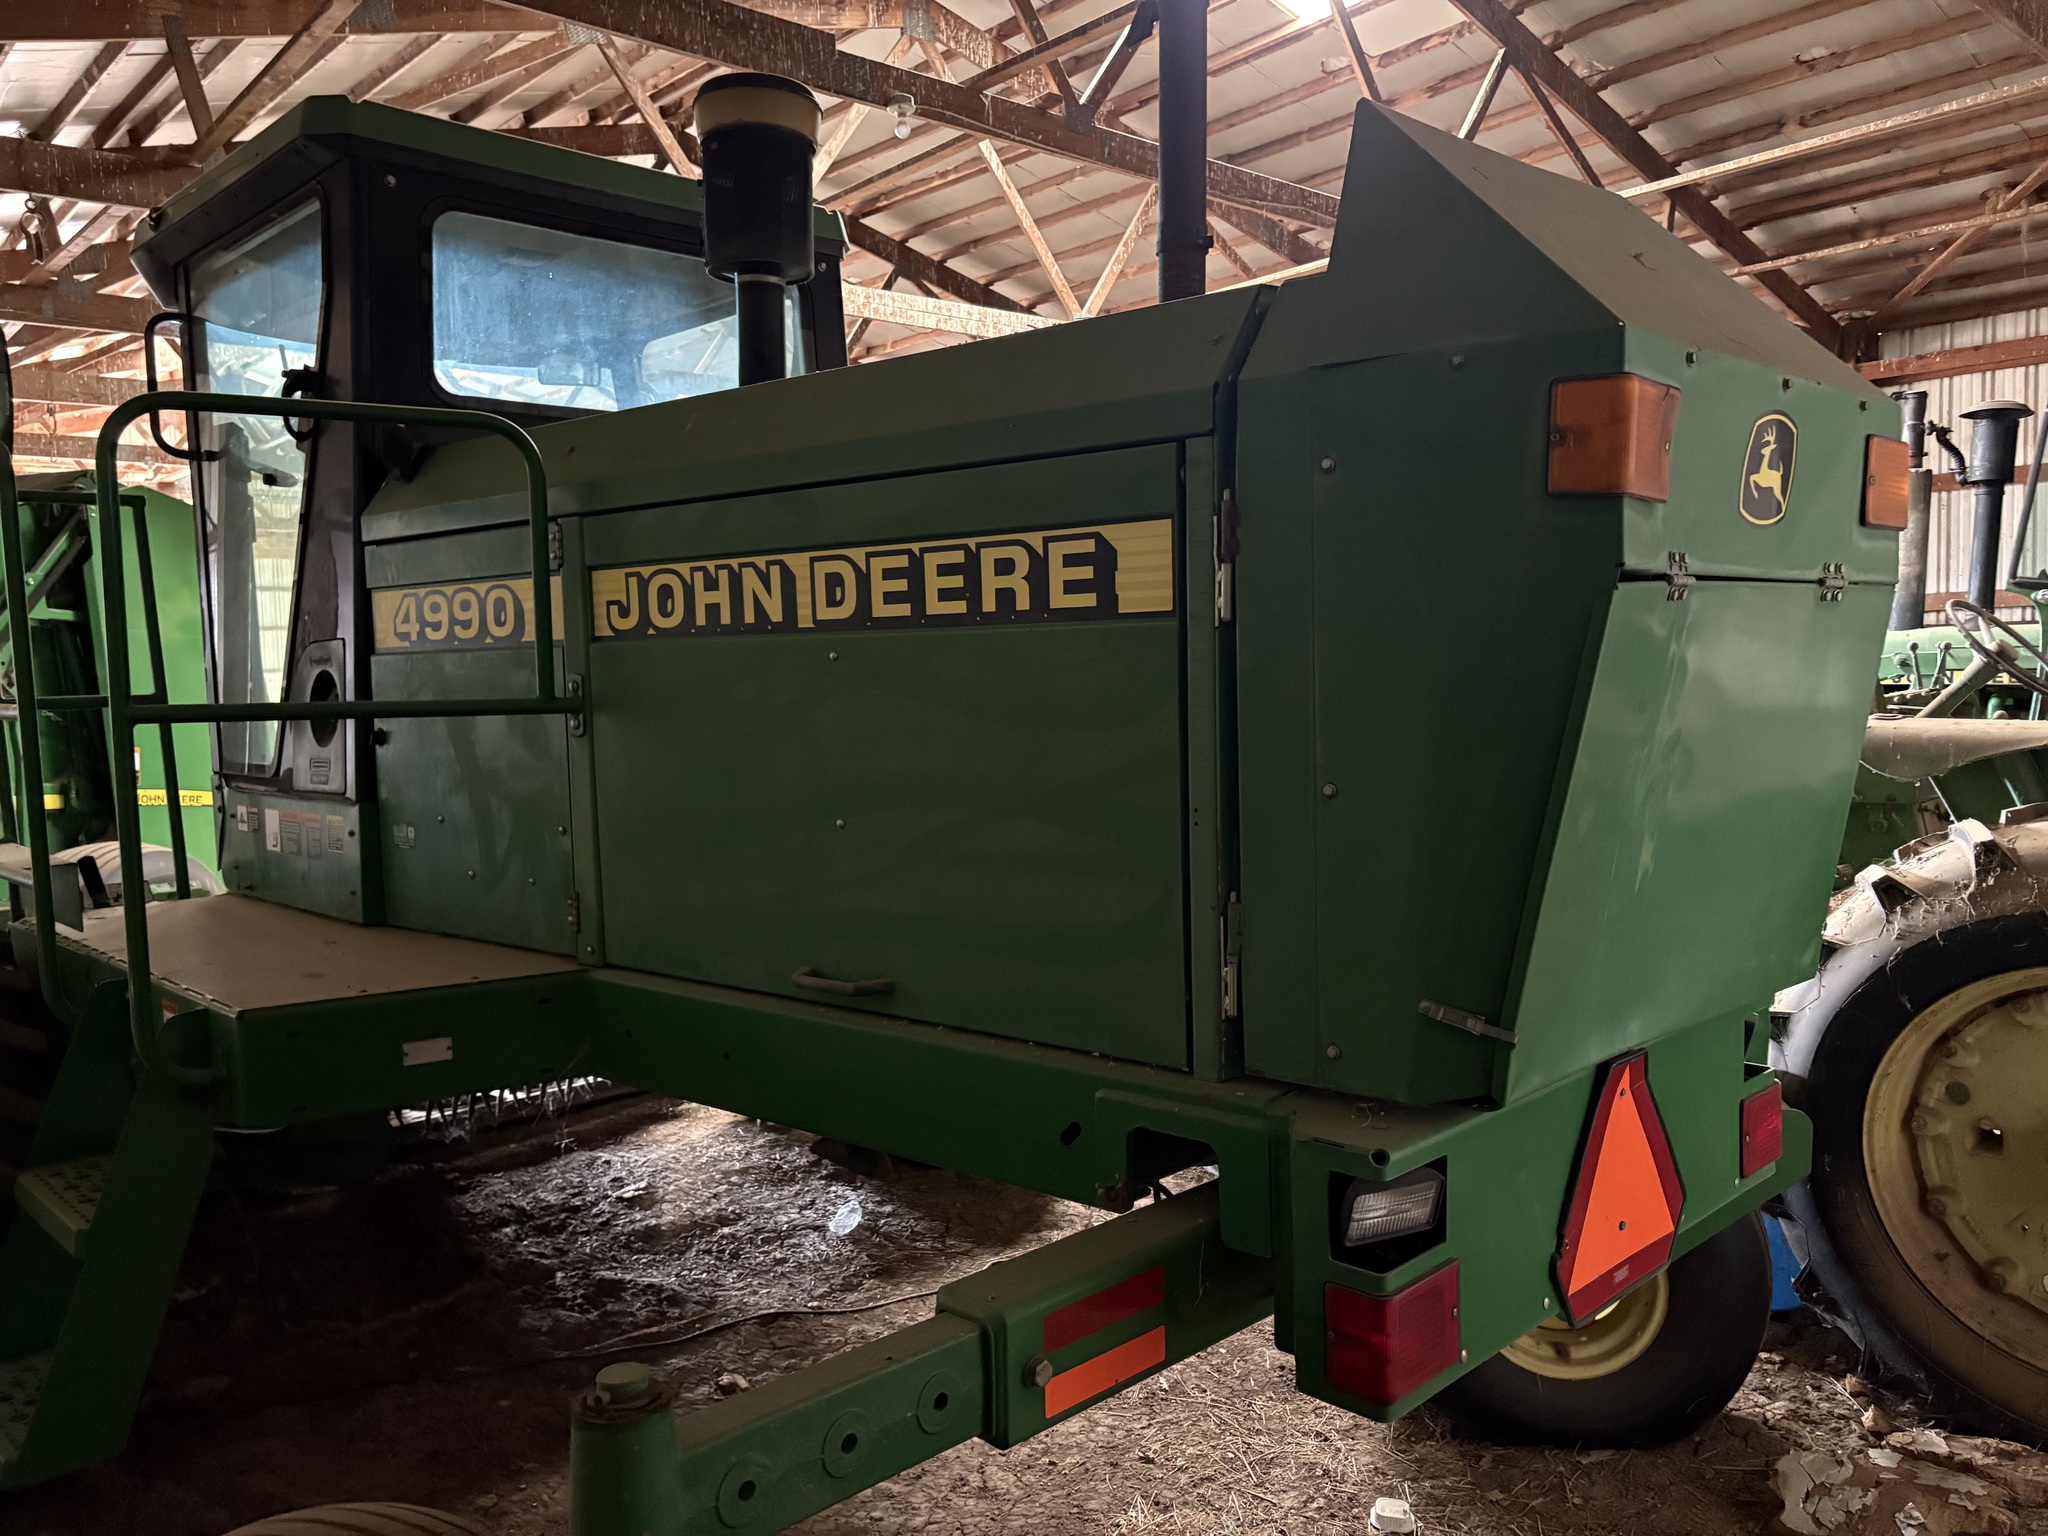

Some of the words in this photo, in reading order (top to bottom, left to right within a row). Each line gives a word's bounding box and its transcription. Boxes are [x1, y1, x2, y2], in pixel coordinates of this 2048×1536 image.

[394, 584, 522, 643] 4990
[607, 561, 789, 634] JOHN
[811, 534, 1106, 622] DEERE
[138, 794, 165, 804] OHN
